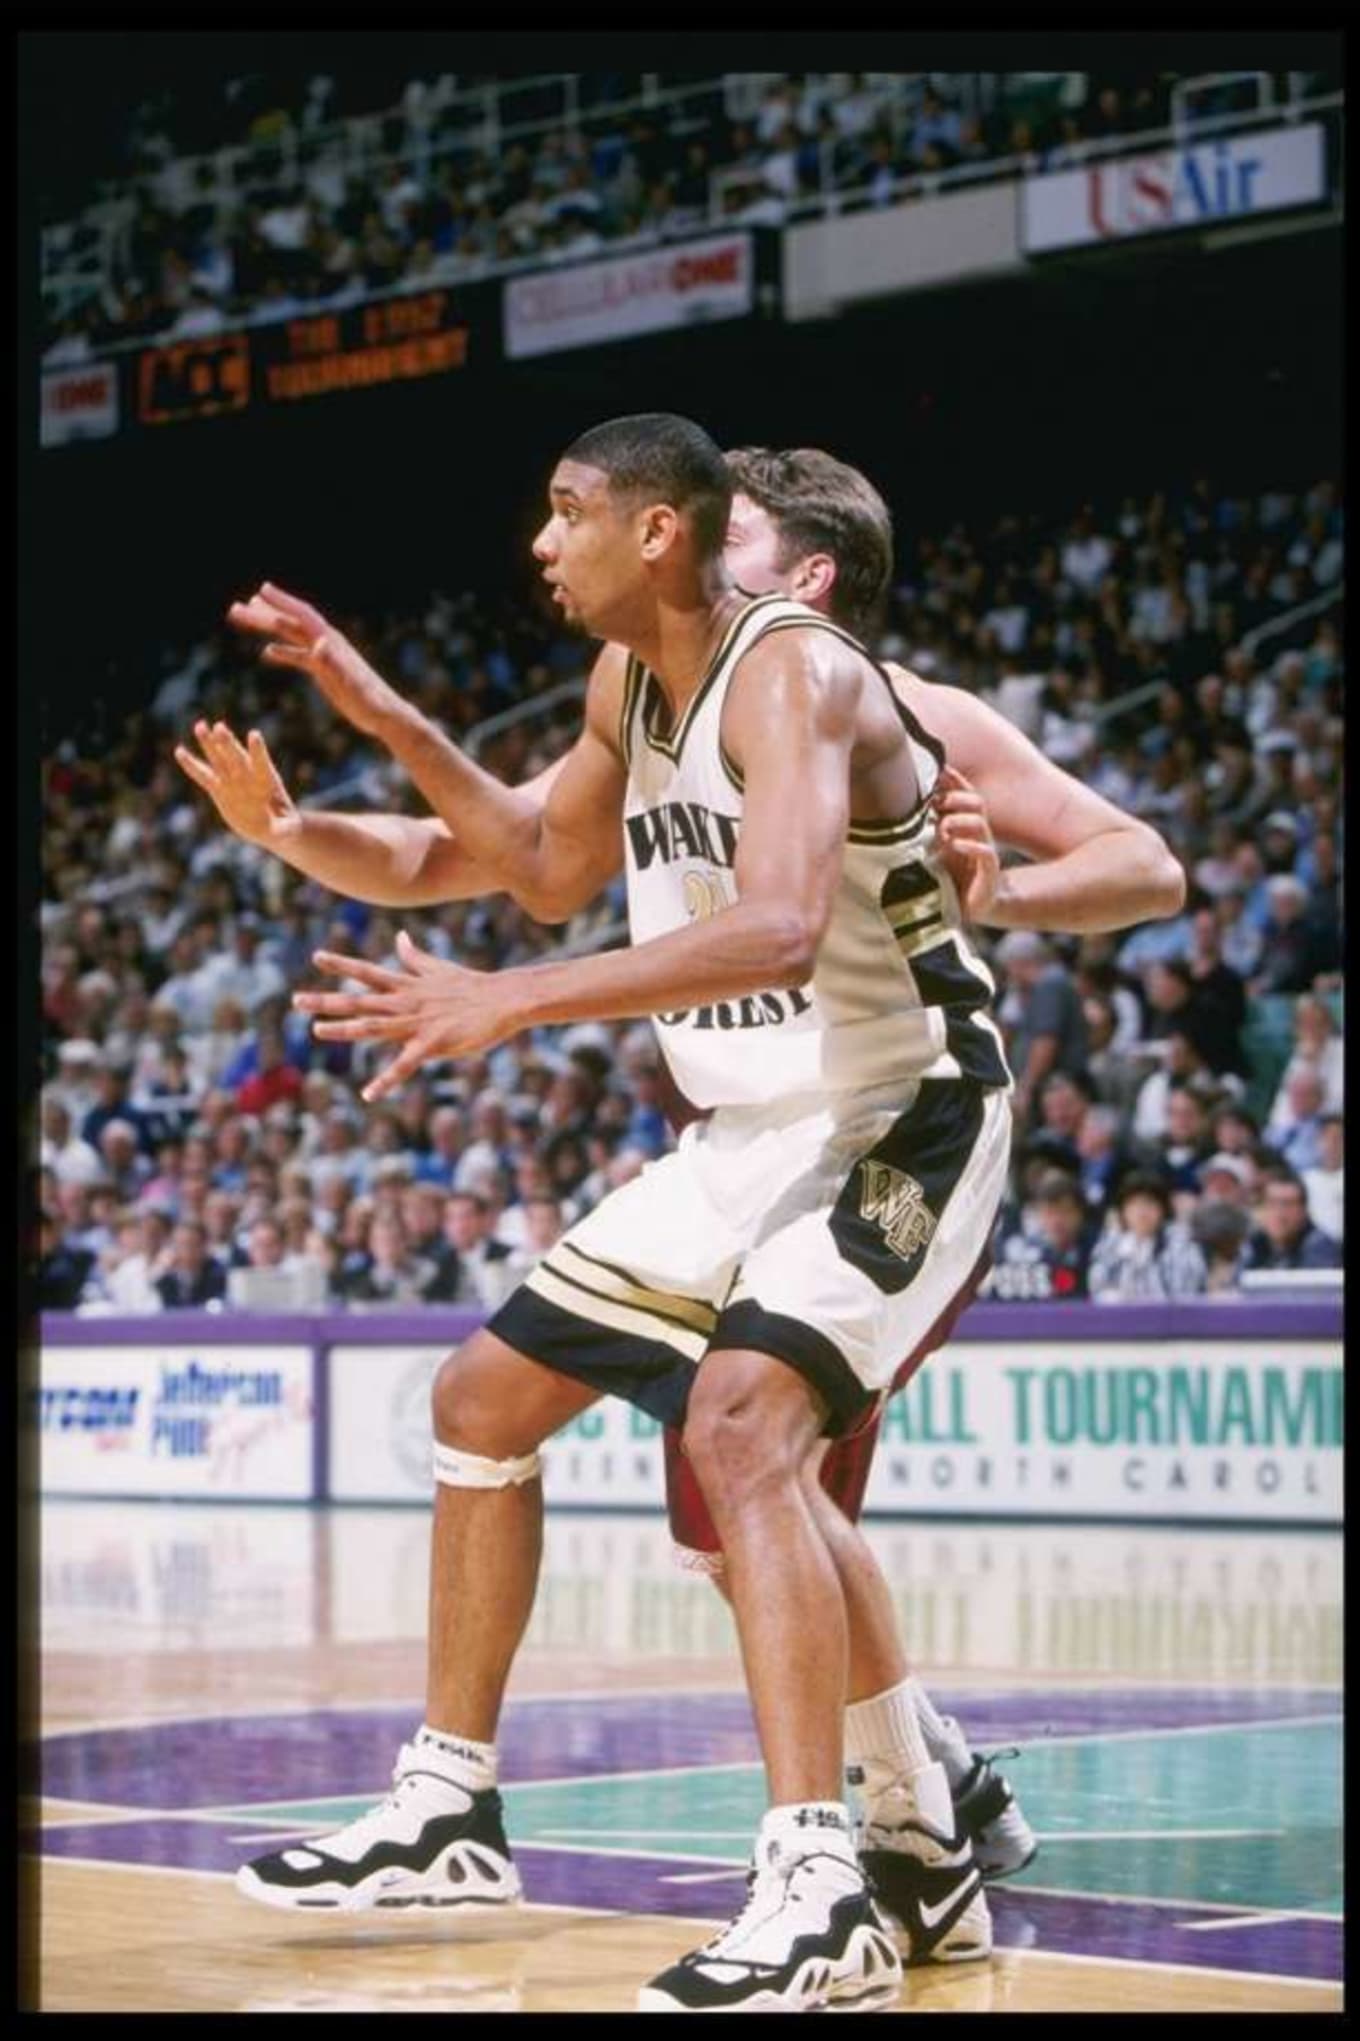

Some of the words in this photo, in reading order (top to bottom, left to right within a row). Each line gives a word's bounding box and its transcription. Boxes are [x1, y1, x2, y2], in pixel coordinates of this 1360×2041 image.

[1087, 142, 1261, 239] USAir
[890, 1457, 1073, 1488] NORTH
[1123, 1458, 1320, 1494] CAROL
